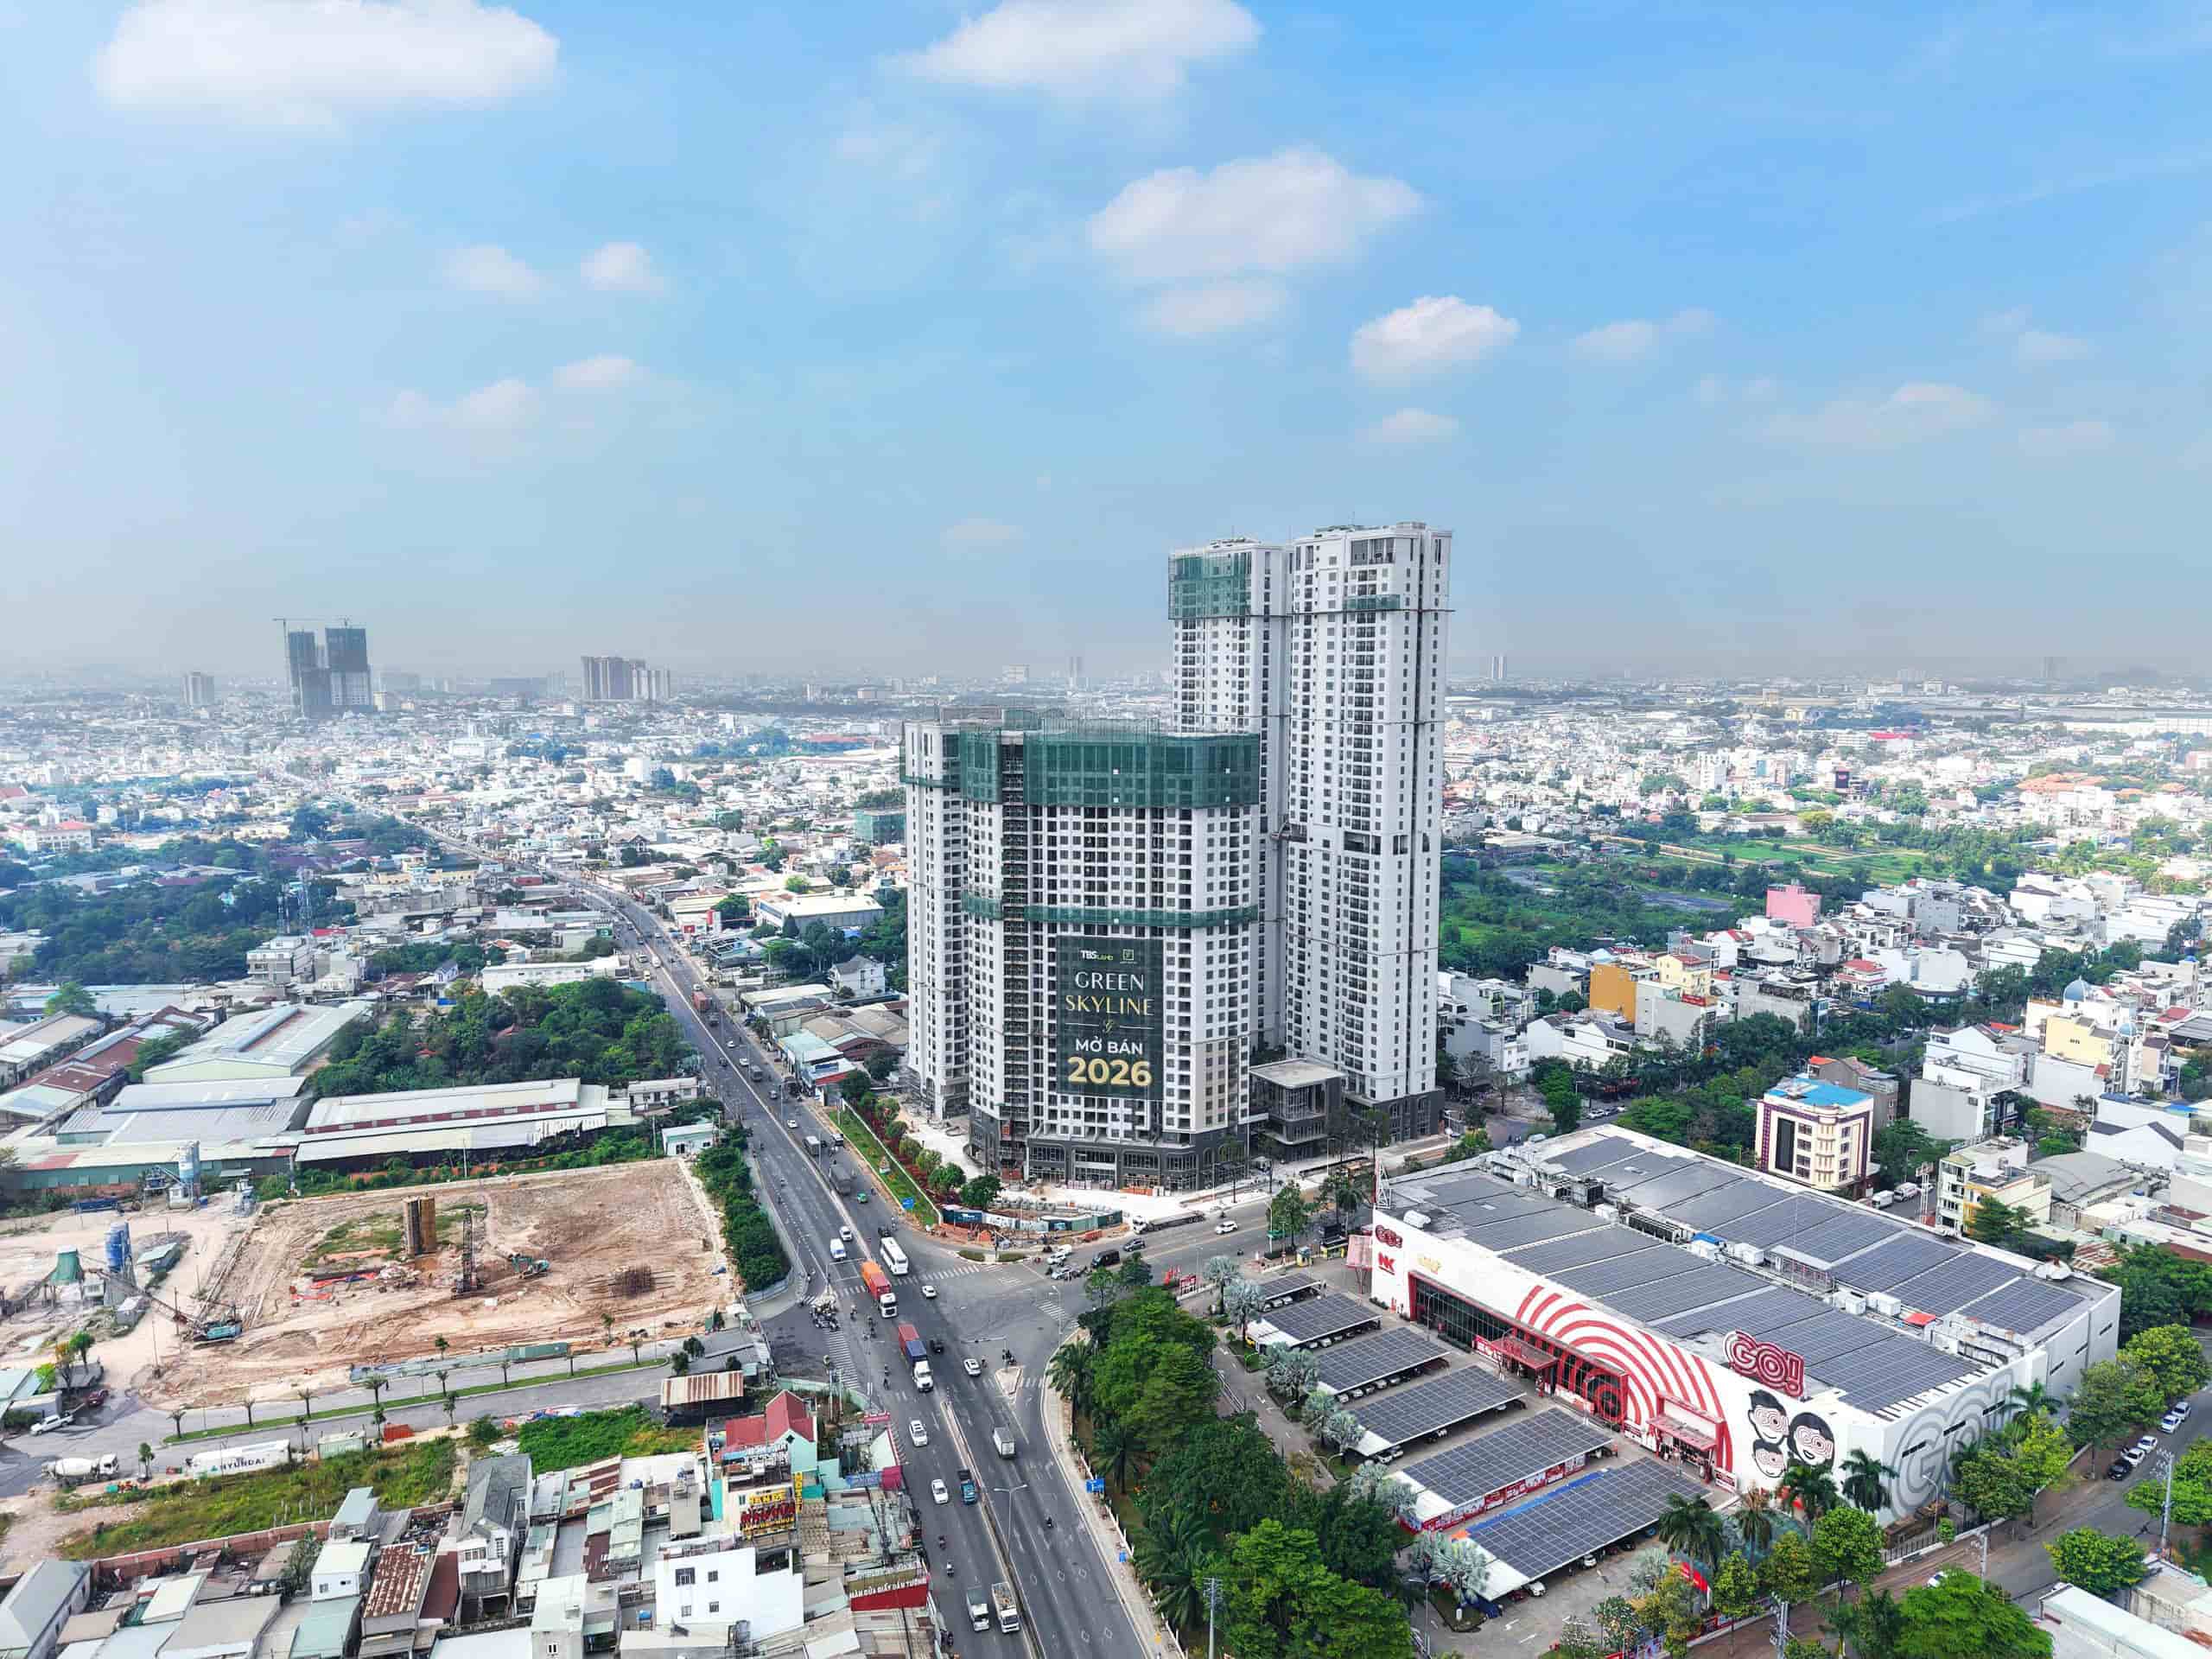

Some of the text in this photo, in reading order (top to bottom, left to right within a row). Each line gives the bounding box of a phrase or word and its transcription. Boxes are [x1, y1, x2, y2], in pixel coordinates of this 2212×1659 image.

[1074, 971, 1144, 992] GREEN
[1065, 995, 1155, 1016] SKYLINE
[1075, 1036, 1143, 1055] MỞ BÁN
[1067, 1056, 1153, 1087] 2026
[1724, 1330, 1805, 1398] GO!
[220, 1458, 265, 1470] HYUNDAI
